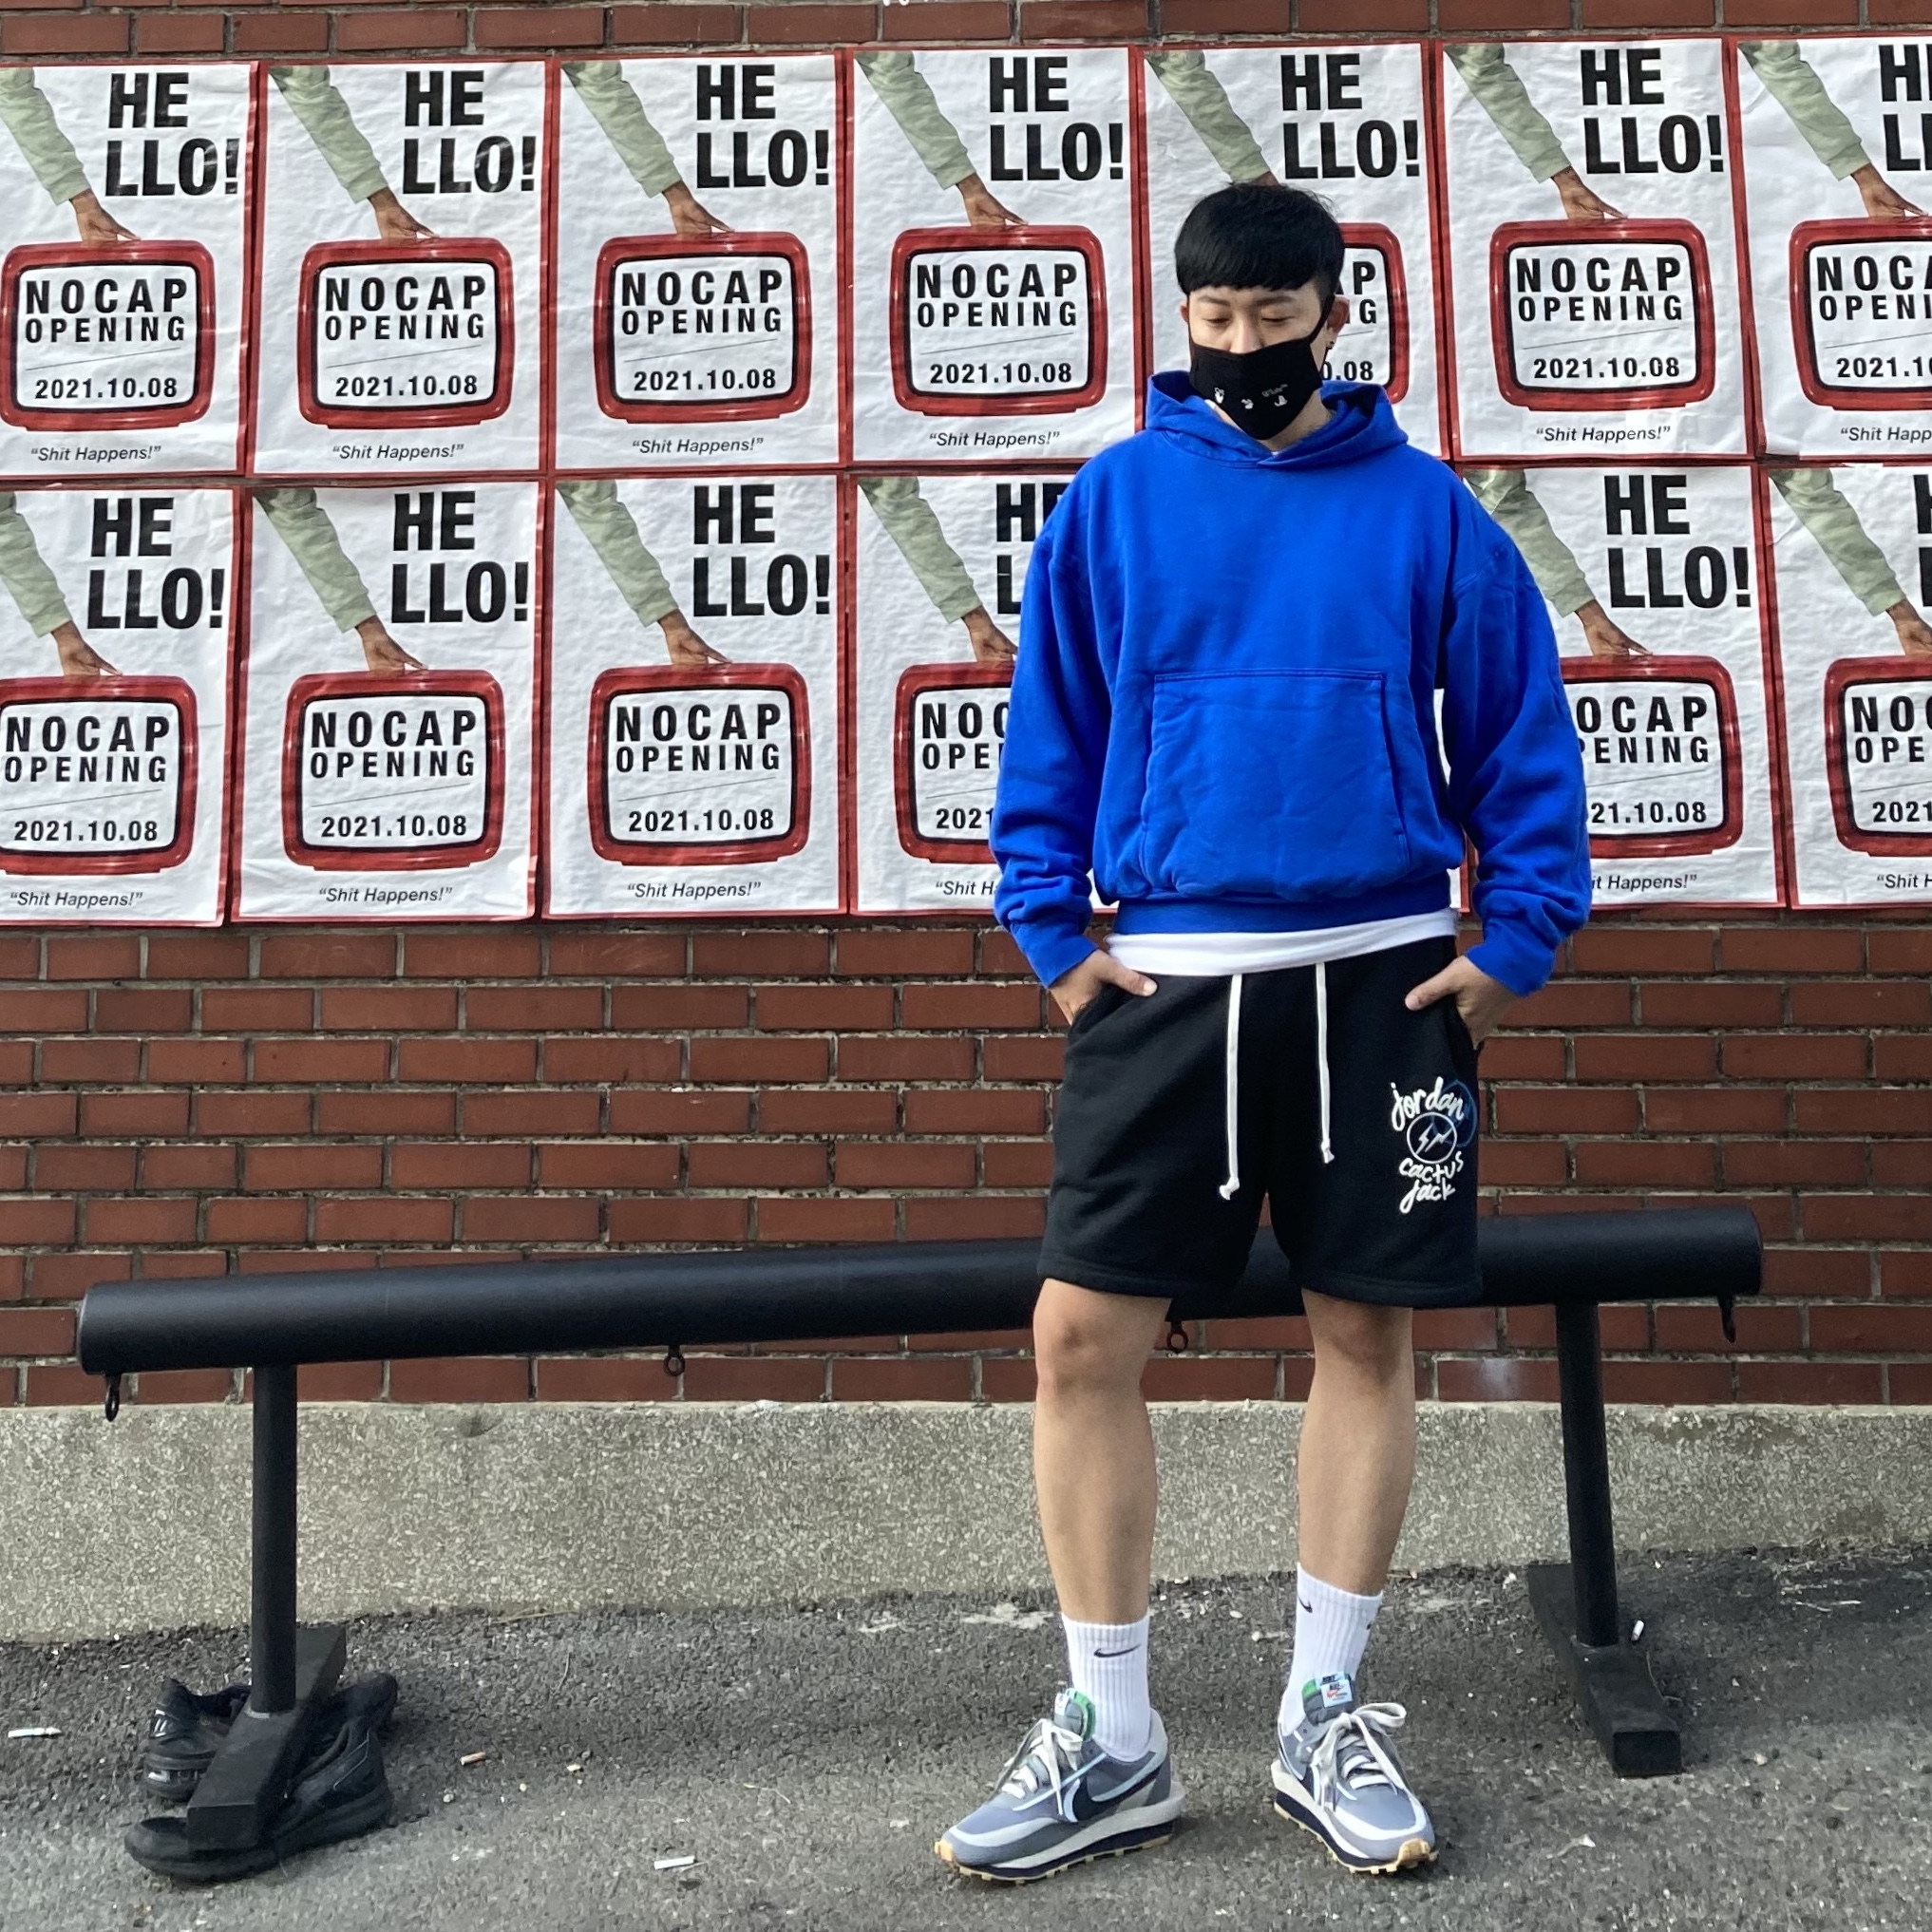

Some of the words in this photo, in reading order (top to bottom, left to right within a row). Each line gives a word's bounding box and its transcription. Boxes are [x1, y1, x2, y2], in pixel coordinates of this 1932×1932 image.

[989, 56, 1070, 113] HE
[1280, 52, 1363, 111] HE
[1580, 47, 1665, 106] HE
[1878, 43, 1932, 103] H
[108, 72, 189, 129] HE
[405, 70, 484, 127] HE
[696, 64, 776, 121] HE
[696, 129, 829, 189] LLO!
[990, 122, 1124, 181] LLO!
[1282, 119, 1420, 180] LLO!
[1583, 114, 1724, 175] LLO!
[104, 138, 239, 197] LLO!
[402, 135, 536, 195] LLO!
[621, 269, 783, 310] NOCAP
[917, 263, 1077, 299] NOCAP
[1516, 256, 1681, 294] NOCAP
[1816, 255, 1932, 292] NOC
[26, 278, 187, 314] NOCAP
[325, 275, 485, 312] NOCAP
[1518, 294, 1682, 322] OPENING
[1819, 294, 1932, 321] OPENI
[25, 312, 184, 344] OPENING
[325, 313, 483, 341] OPENING
[621, 307, 781, 335] OPENING
[917, 301, 1076, 328] OPENING
[634, 368, 776, 391] 2021.10.08
[930, 362, 1072, 384] 2021.10.08
[1533, 357, 1680, 379] 2021.10.08
[1836, 356, 1932, 378] 2021.1
[35, 377, 178, 399] 2021.10.08
[335, 374, 478, 397] 2021.10.08
[632, 439, 672, 454] “Shit
[676, 437, 764, 455] Happens!”
[929, 432, 970, 446] “Shit
[974, 431, 1060, 448] Happens!”
[1536, 427, 1578, 442] “Shit
[1582, 426, 1671, 444] Happens!”
[1840, 426, 1883, 442] “Shit
[30, 447, 71, 462] “Shit
[75, 445, 161, 463] Happens!”
[332, 445, 372, 460] “Shit
[376, 444, 464, 462] Happens!”
[392, 490, 476, 552] HE
[693, 483, 775, 545] HE
[995, 483, 1068, 542] H
[1603, 474, 1691, 536] HE
[90, 497, 175, 558] HE
[390, 561, 529, 624] LLO!
[692, 554, 830, 617] LLO!
[1607, 545, 1752, 609] LLO!
[86, 567, 225, 630] LLO!
[311, 710, 476, 748] NOCAP
[616, 703, 781, 743] NOCAP
[921, 702, 1009, 739] NOC
[1576, 695, 1708, 734] OCAP
[6, 715, 170, 752] NOCAP
[1580, 736, 1709, 764] ENING
[5, 755, 166, 783] OPENING
[310, 749, 474, 779] OPENING
[616, 743, 779, 773] OPENING
[321, 815, 466, 838] 2021.10.08
[629, 808, 774, 832] 2021.10.08
[1591, 801, 1707, 824] 21.10.08
[13, 820, 158, 842] 2021.10.08
[319, 887, 360, 902] “Shit
[364, 887, 453, 905] Happens!”
[628, 882, 668, 898] “Shit
[672, 881, 762, 900] Happens!”
[936, 881, 976, 896] “Shit
[1607, 873, 1697, 892] Happens!”
[1876, 873, 1919, 889] “Shit
[10, 891, 50, 906] “Shit
[54, 892, 143, 909] Happens!”
